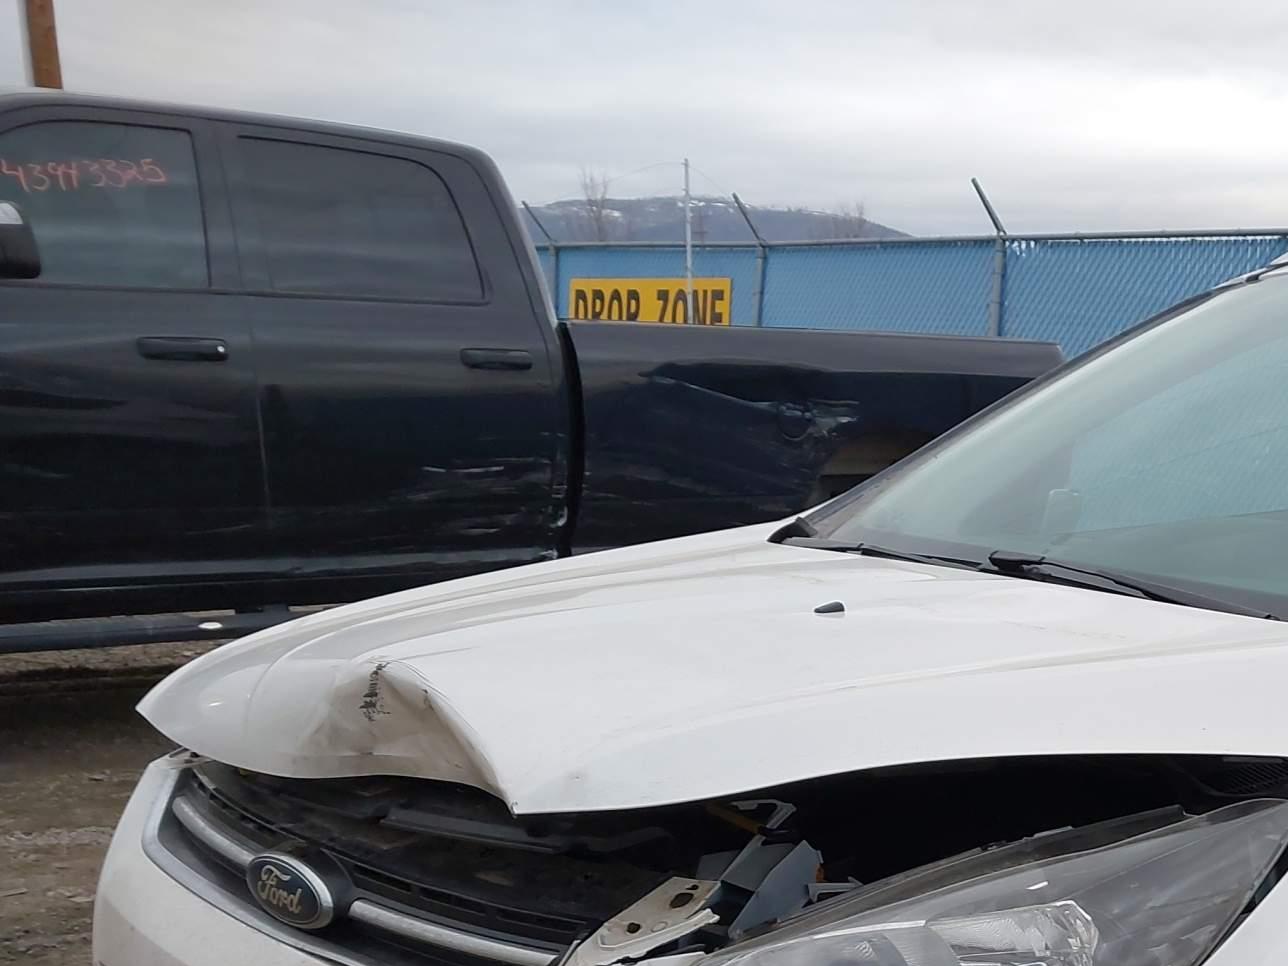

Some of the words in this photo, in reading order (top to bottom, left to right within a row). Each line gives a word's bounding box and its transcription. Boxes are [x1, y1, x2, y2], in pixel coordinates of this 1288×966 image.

[574, 288, 641, 321] DROP
[657, 288, 725, 325] ZONE
[257, 865, 302, 914] Ford
